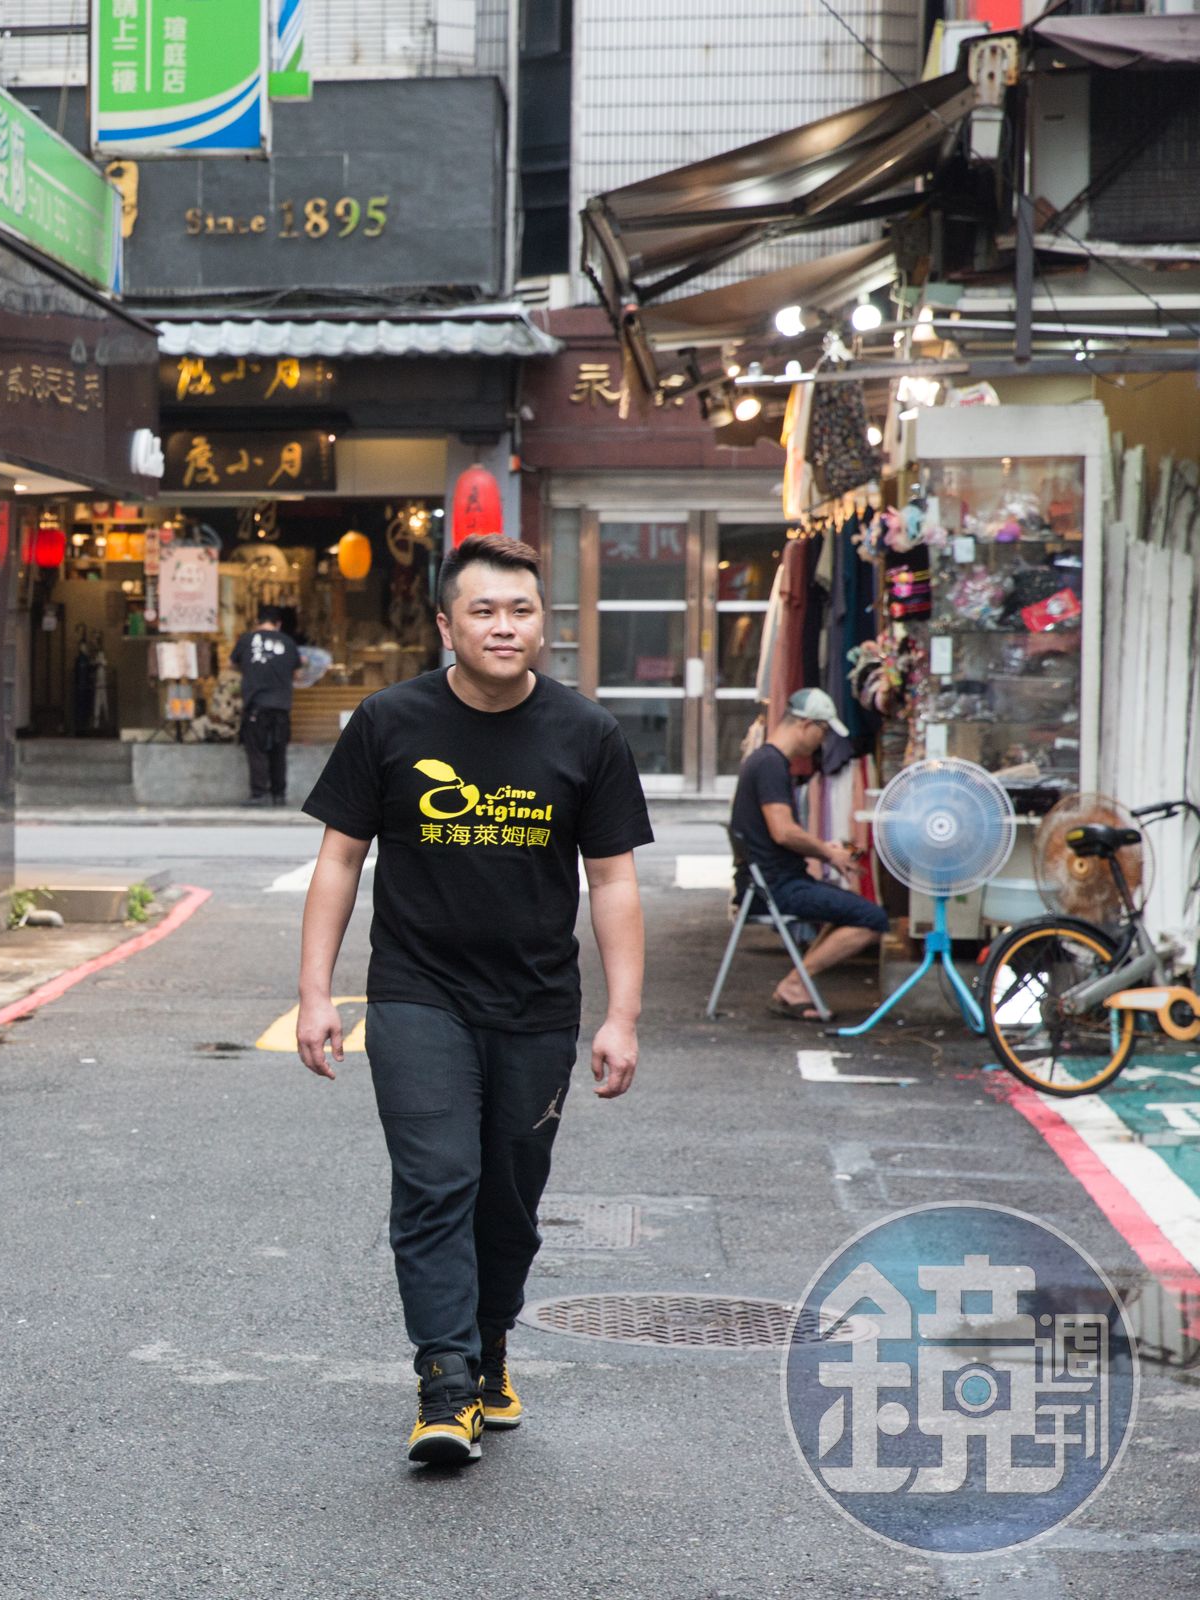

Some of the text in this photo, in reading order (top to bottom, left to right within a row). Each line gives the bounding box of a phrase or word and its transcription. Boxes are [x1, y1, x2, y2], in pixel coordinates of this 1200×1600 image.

[278, 196, 390, 238] 1895
[484, 785, 537, 801] Lime
[420, 822, 551, 848] 東海萊姆園
